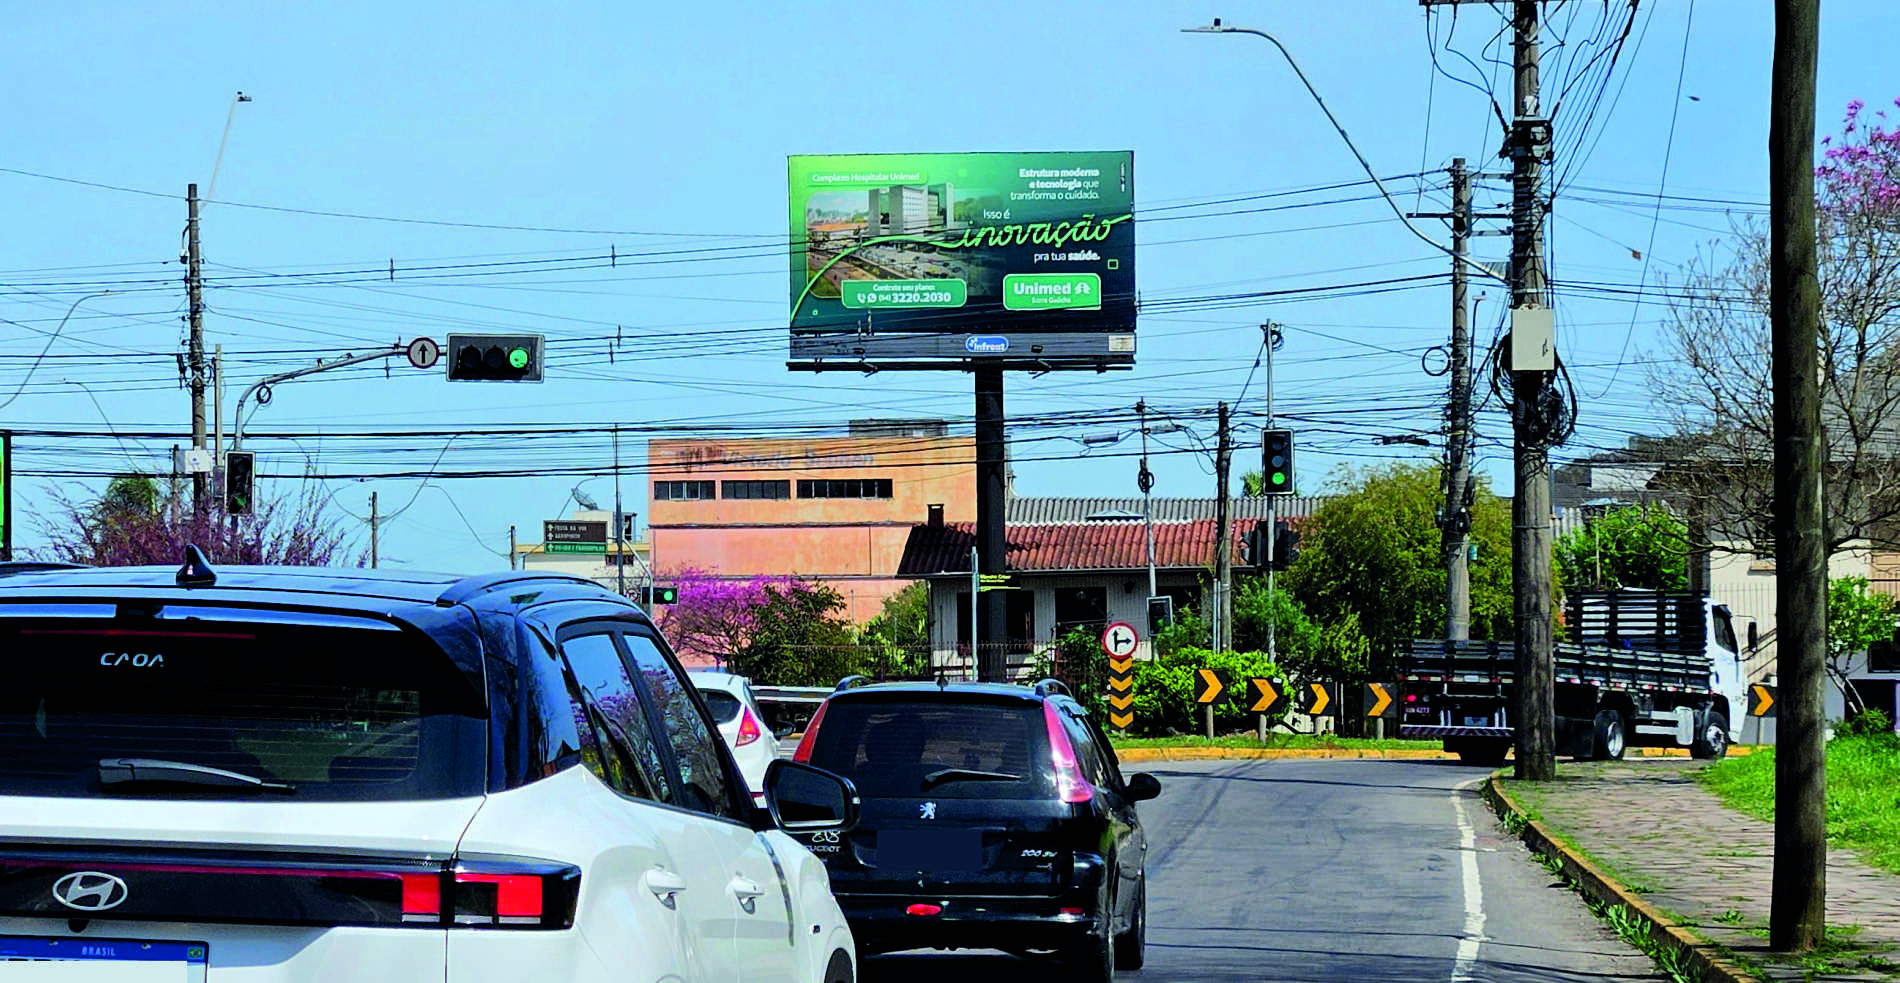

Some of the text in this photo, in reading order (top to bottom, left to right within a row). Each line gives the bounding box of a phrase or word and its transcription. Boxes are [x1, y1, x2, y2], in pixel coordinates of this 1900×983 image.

[851, 172, 888, 182] Hospitalar
[890, 171, 920, 181] Unimed
[1019, 167, 1100, 177] Estrutura moderna
[1029, 179, 1099, 190] e tecnologia que
[1010, 190, 1056, 200] transforma
[1057, 192, 1064, 200] o
[983, 208, 1011, 219] Isso é
[962, 212, 1132, 248] inovação
[1034, 250, 1100, 264] pra tua saúde.
[1014, 282, 1072, 295] Unimed
[892, 292, 951, 303] 3220.2030
[81, 946, 116, 957] BRASIL
